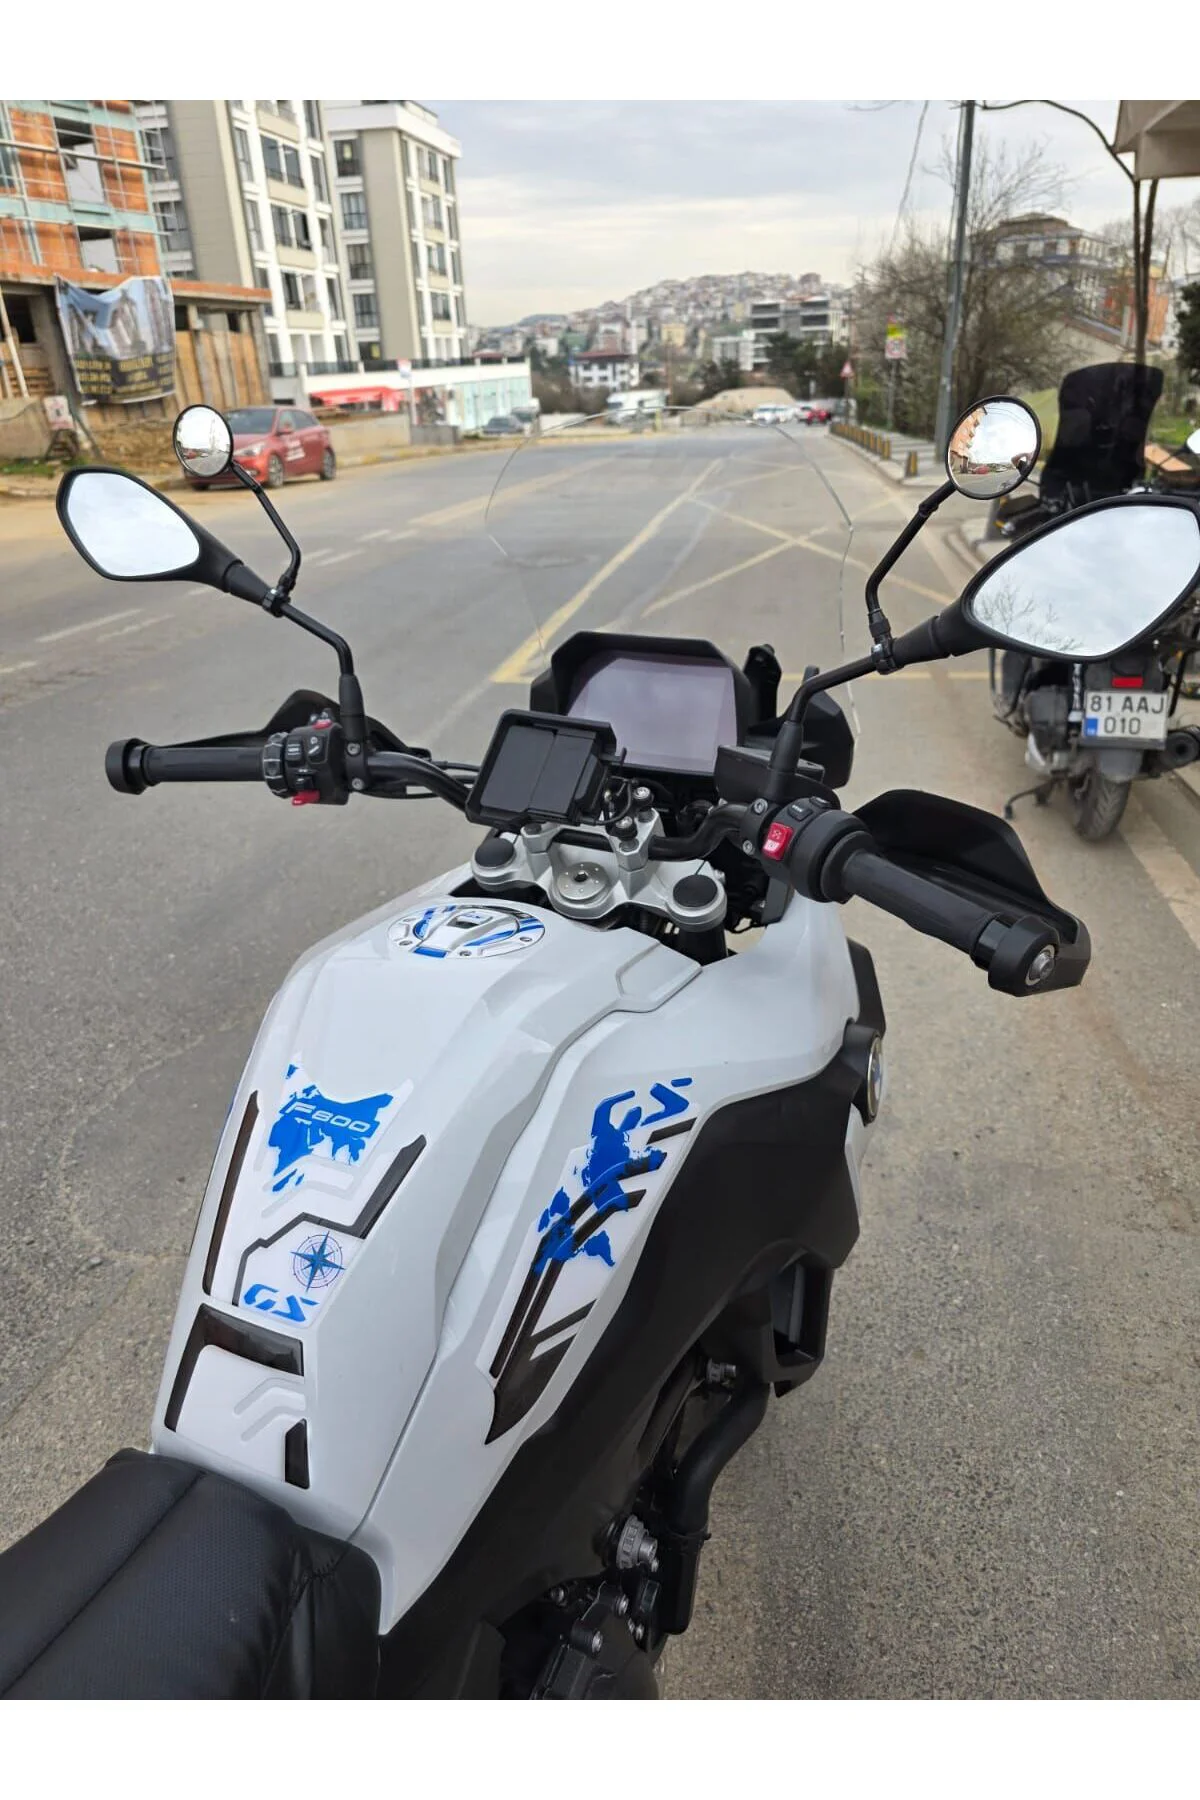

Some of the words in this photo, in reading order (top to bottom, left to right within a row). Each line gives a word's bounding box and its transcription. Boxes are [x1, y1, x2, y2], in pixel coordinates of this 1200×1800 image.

[1091, 695, 1112, 712] 81
[1122, 696, 1164, 714] AAJ
[1104, 716, 1141, 735] 010
[284, 1101, 371, 1133] F800
